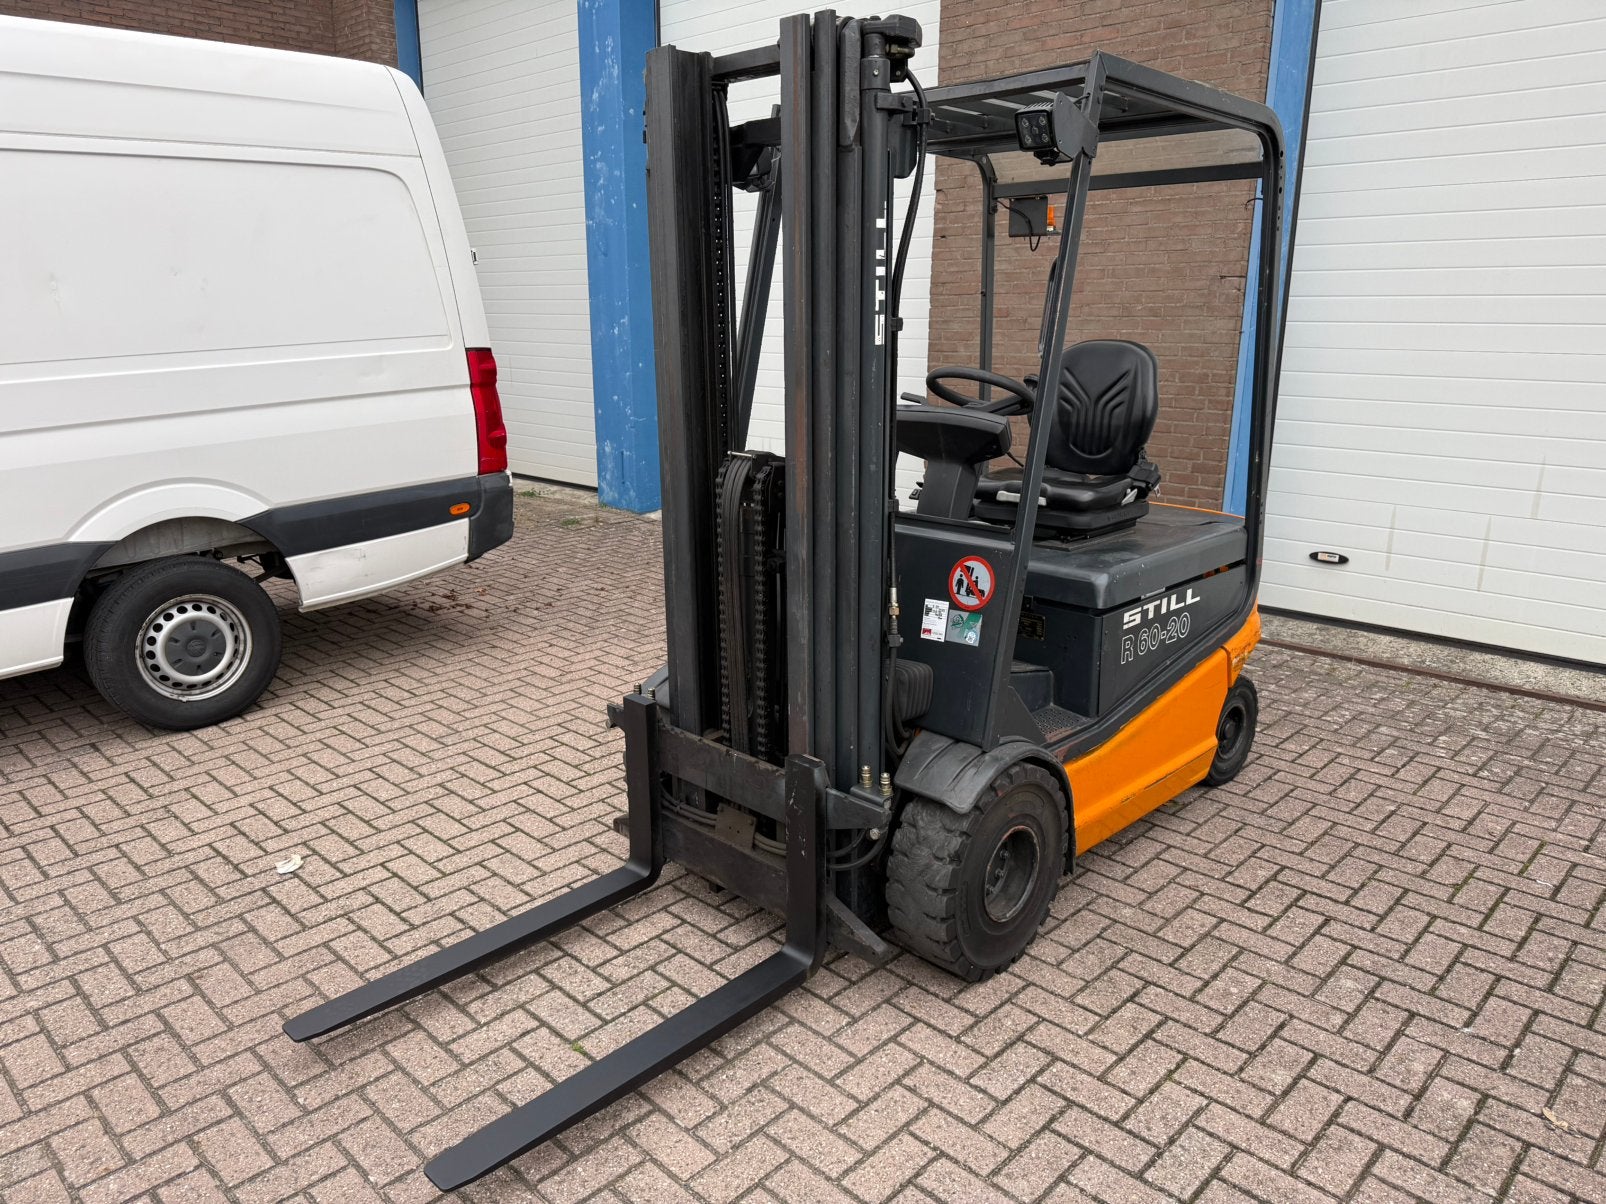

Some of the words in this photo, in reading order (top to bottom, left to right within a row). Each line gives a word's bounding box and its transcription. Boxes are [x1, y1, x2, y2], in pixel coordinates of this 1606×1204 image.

[1122, 588, 1201, 630] STILL
[1120, 634, 1135, 665] R
[1137, 612, 1191, 655] 60-20
